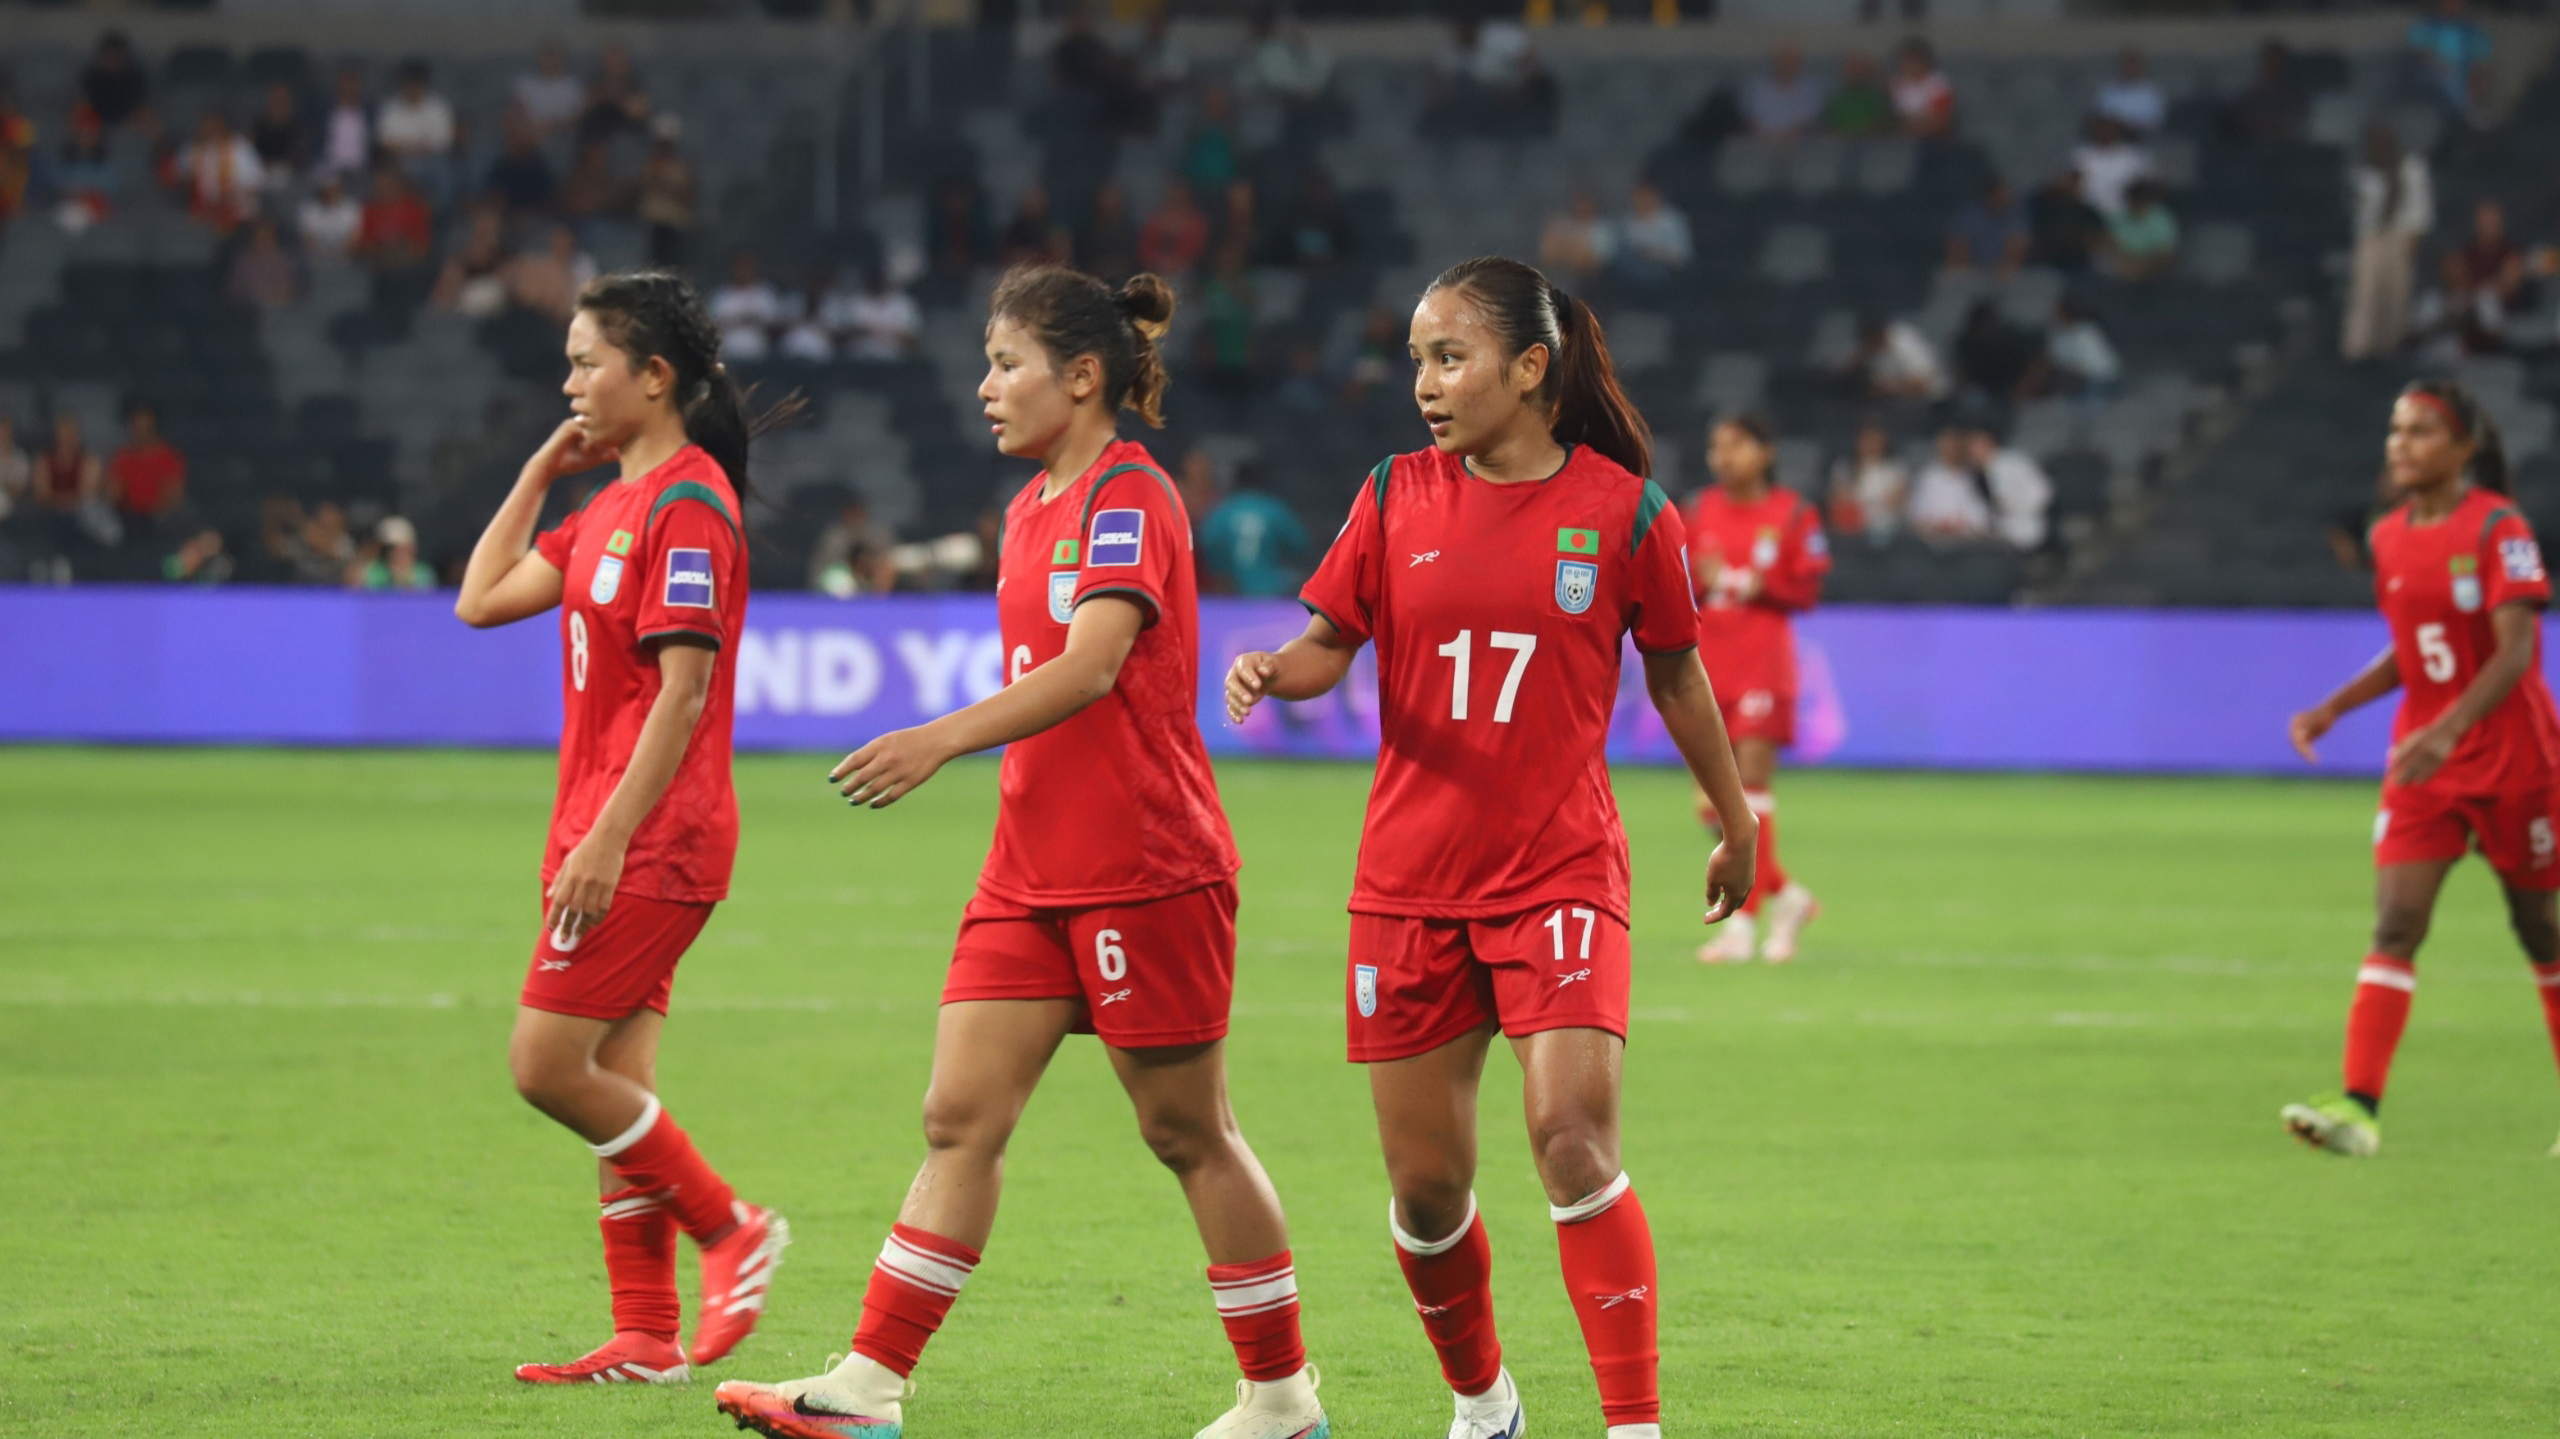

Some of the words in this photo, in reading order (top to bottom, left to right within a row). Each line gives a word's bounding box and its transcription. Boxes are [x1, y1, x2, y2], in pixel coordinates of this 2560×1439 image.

[569, 611, 588, 691] 8
[1438, 629, 1537, 723] 17
[2416, 622, 2456, 683] 5
[2530, 817, 2554, 854] 5
[1095, 928, 1127, 981] 6
[1544, 908, 1595, 960] 17
